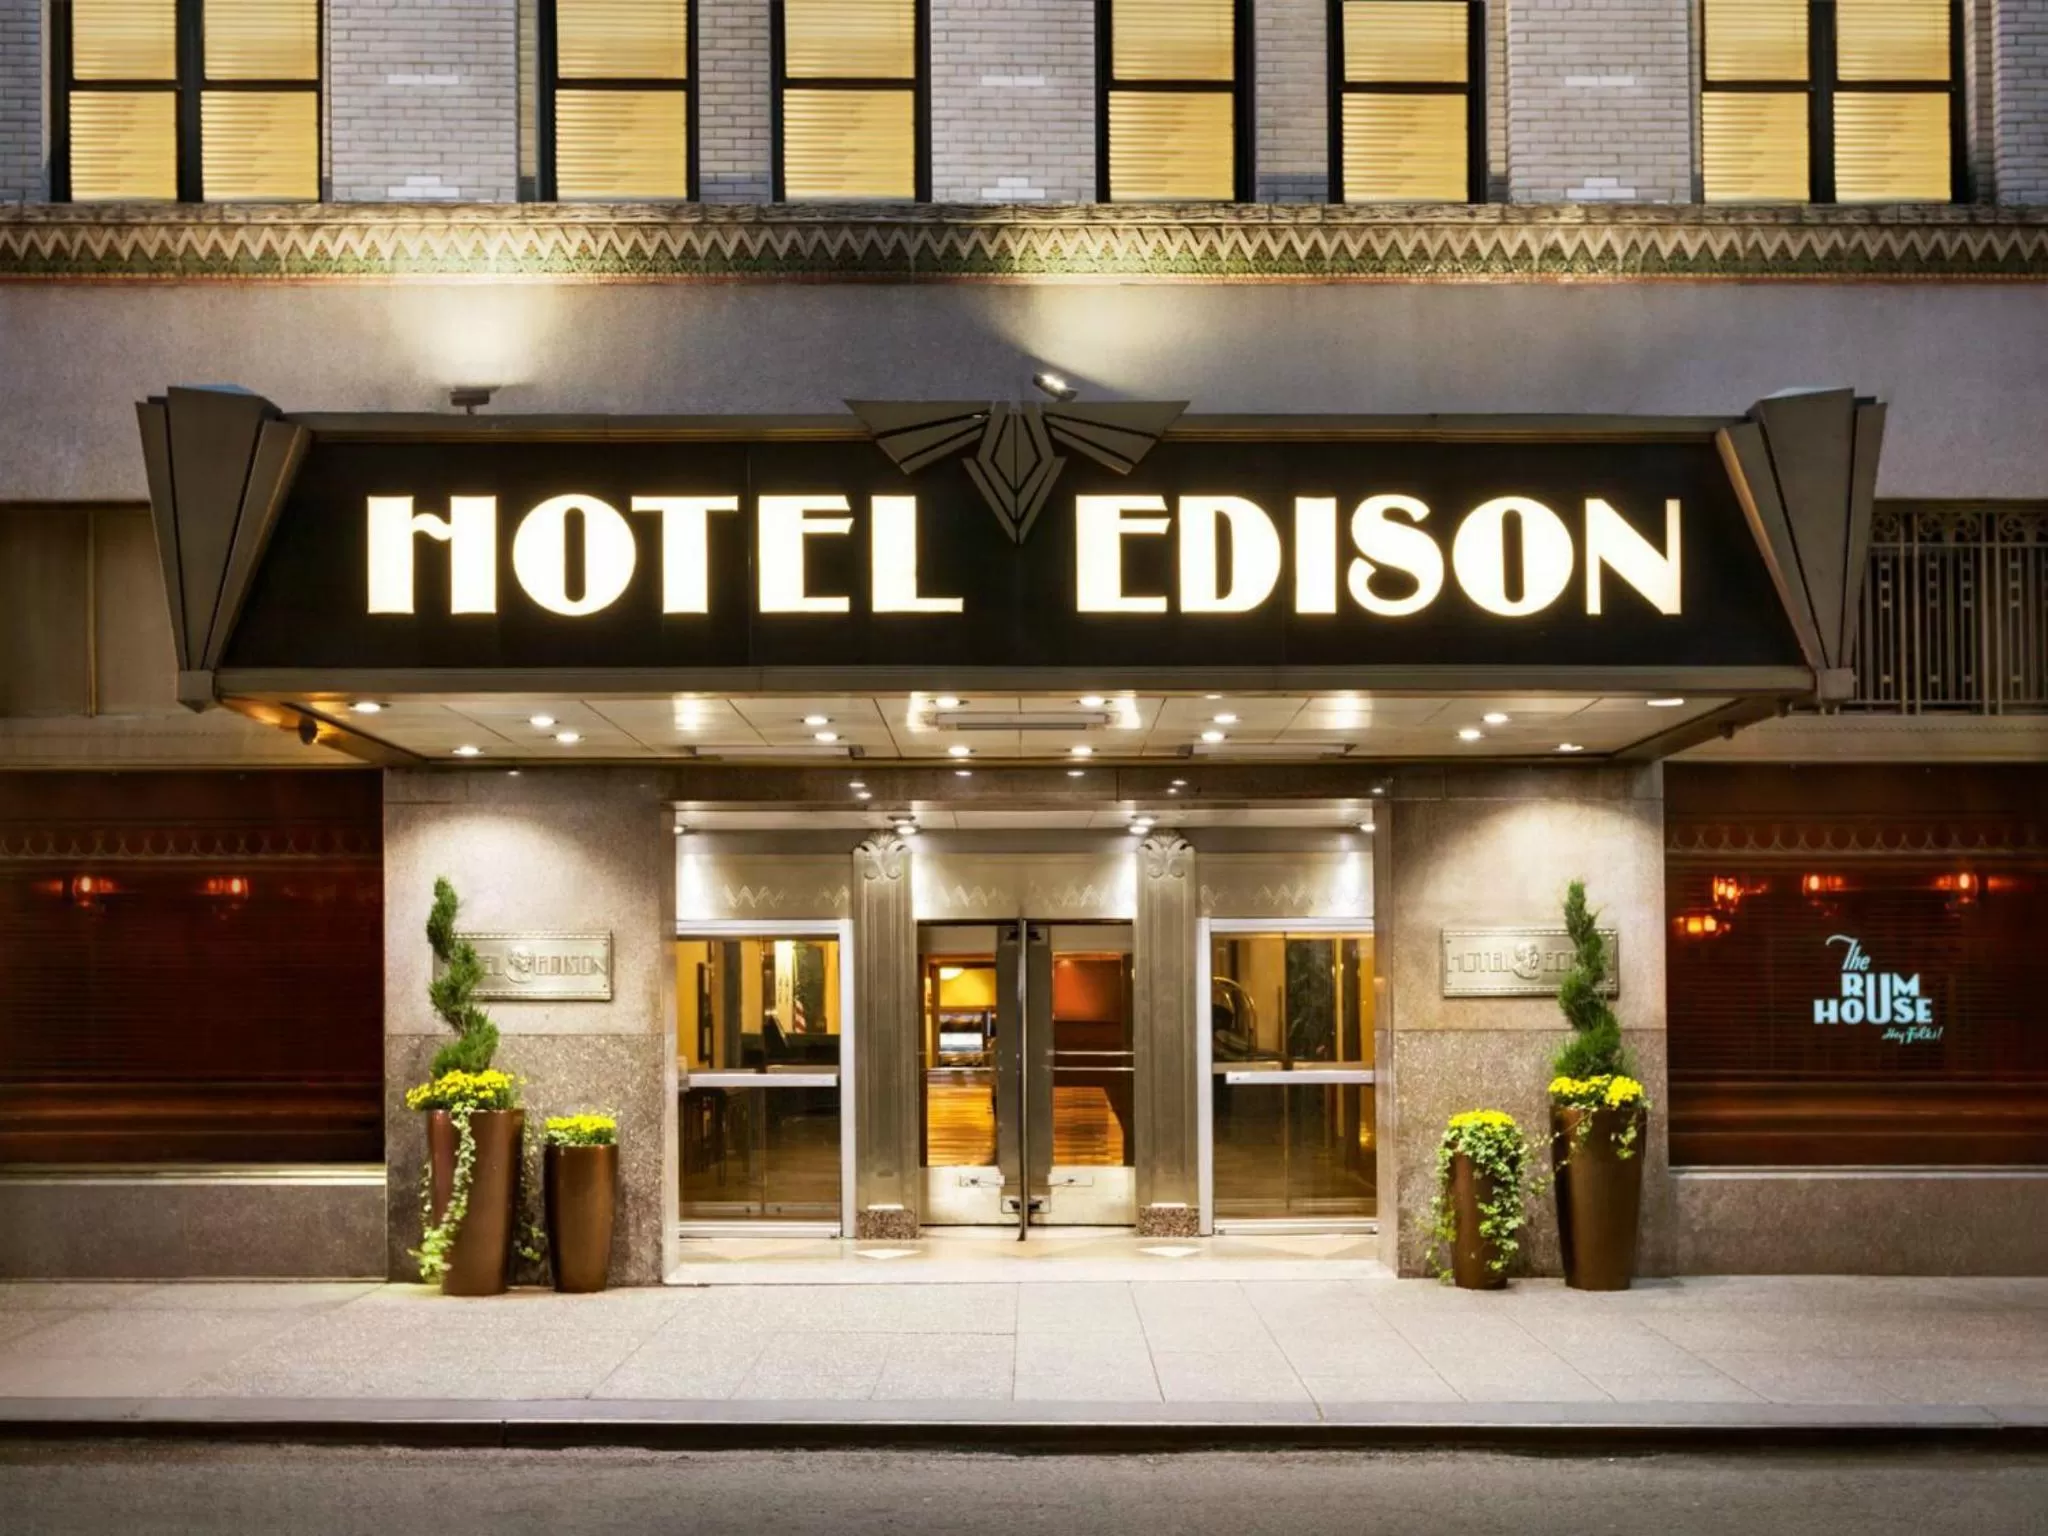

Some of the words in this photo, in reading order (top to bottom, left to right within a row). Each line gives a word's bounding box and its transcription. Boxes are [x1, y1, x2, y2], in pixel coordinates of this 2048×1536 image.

[367, 493, 964, 617] HOTEL
[1075, 493, 1682, 617] EDISON
[1825, 934, 1871, 971] The
[1813, 997, 1933, 1025] HOUSE
